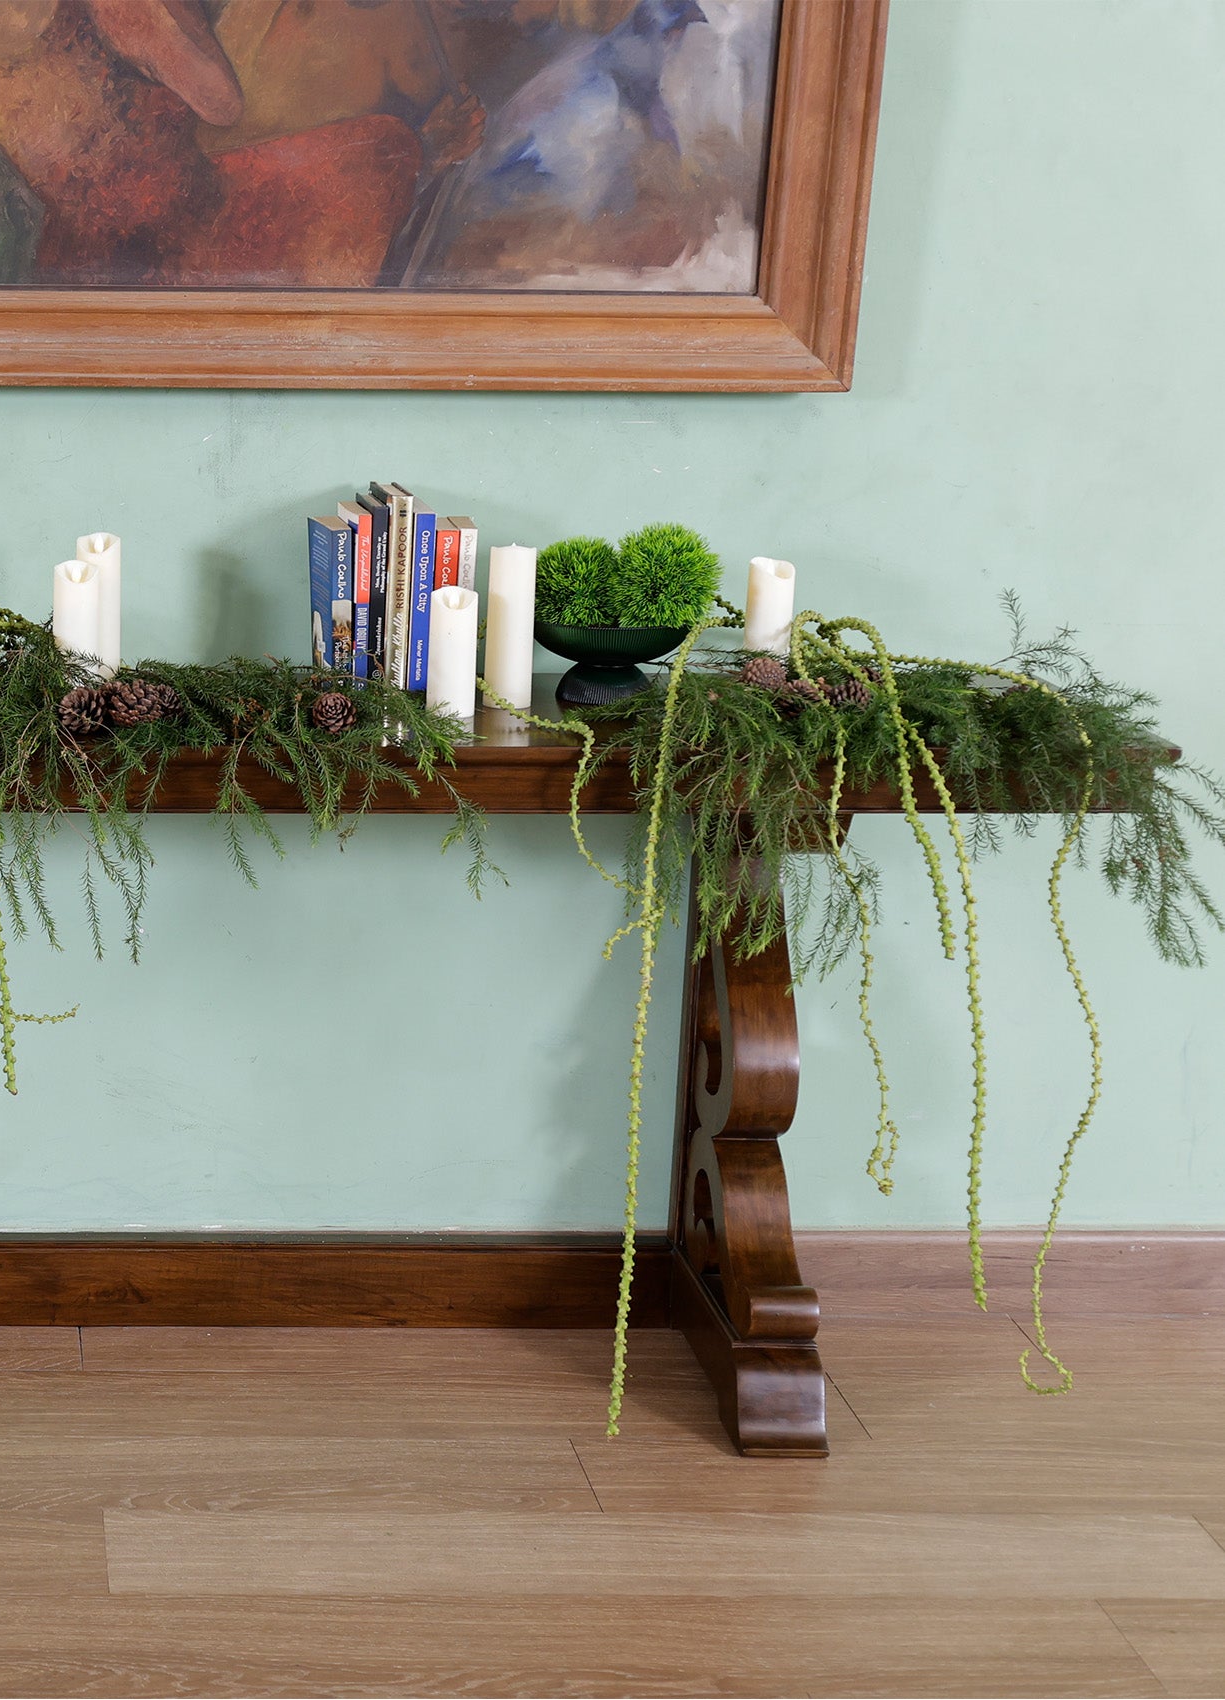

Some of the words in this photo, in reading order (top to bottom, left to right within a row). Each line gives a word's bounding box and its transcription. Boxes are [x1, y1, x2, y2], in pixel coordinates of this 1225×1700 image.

[337, 532, 348, 561] Paulo
[397, 527, 407, 575] KAPOOR
[421, 530, 430, 554] Once
[443, 536, 453, 564] Paulo
[464, 535, 473, 561] Paulo
[419, 556, 429, 580] Upon
[441, 567, 451, 586] Coel
[463, 564, 471, 589] Coelh
[338, 564, 347, 598] Coelho
[395, 579, 405, 608] RISHI
[416, 592, 427, 613] City
[357, 608, 367, 626] DAVID
[356, 628, 367, 649] OGILVY
